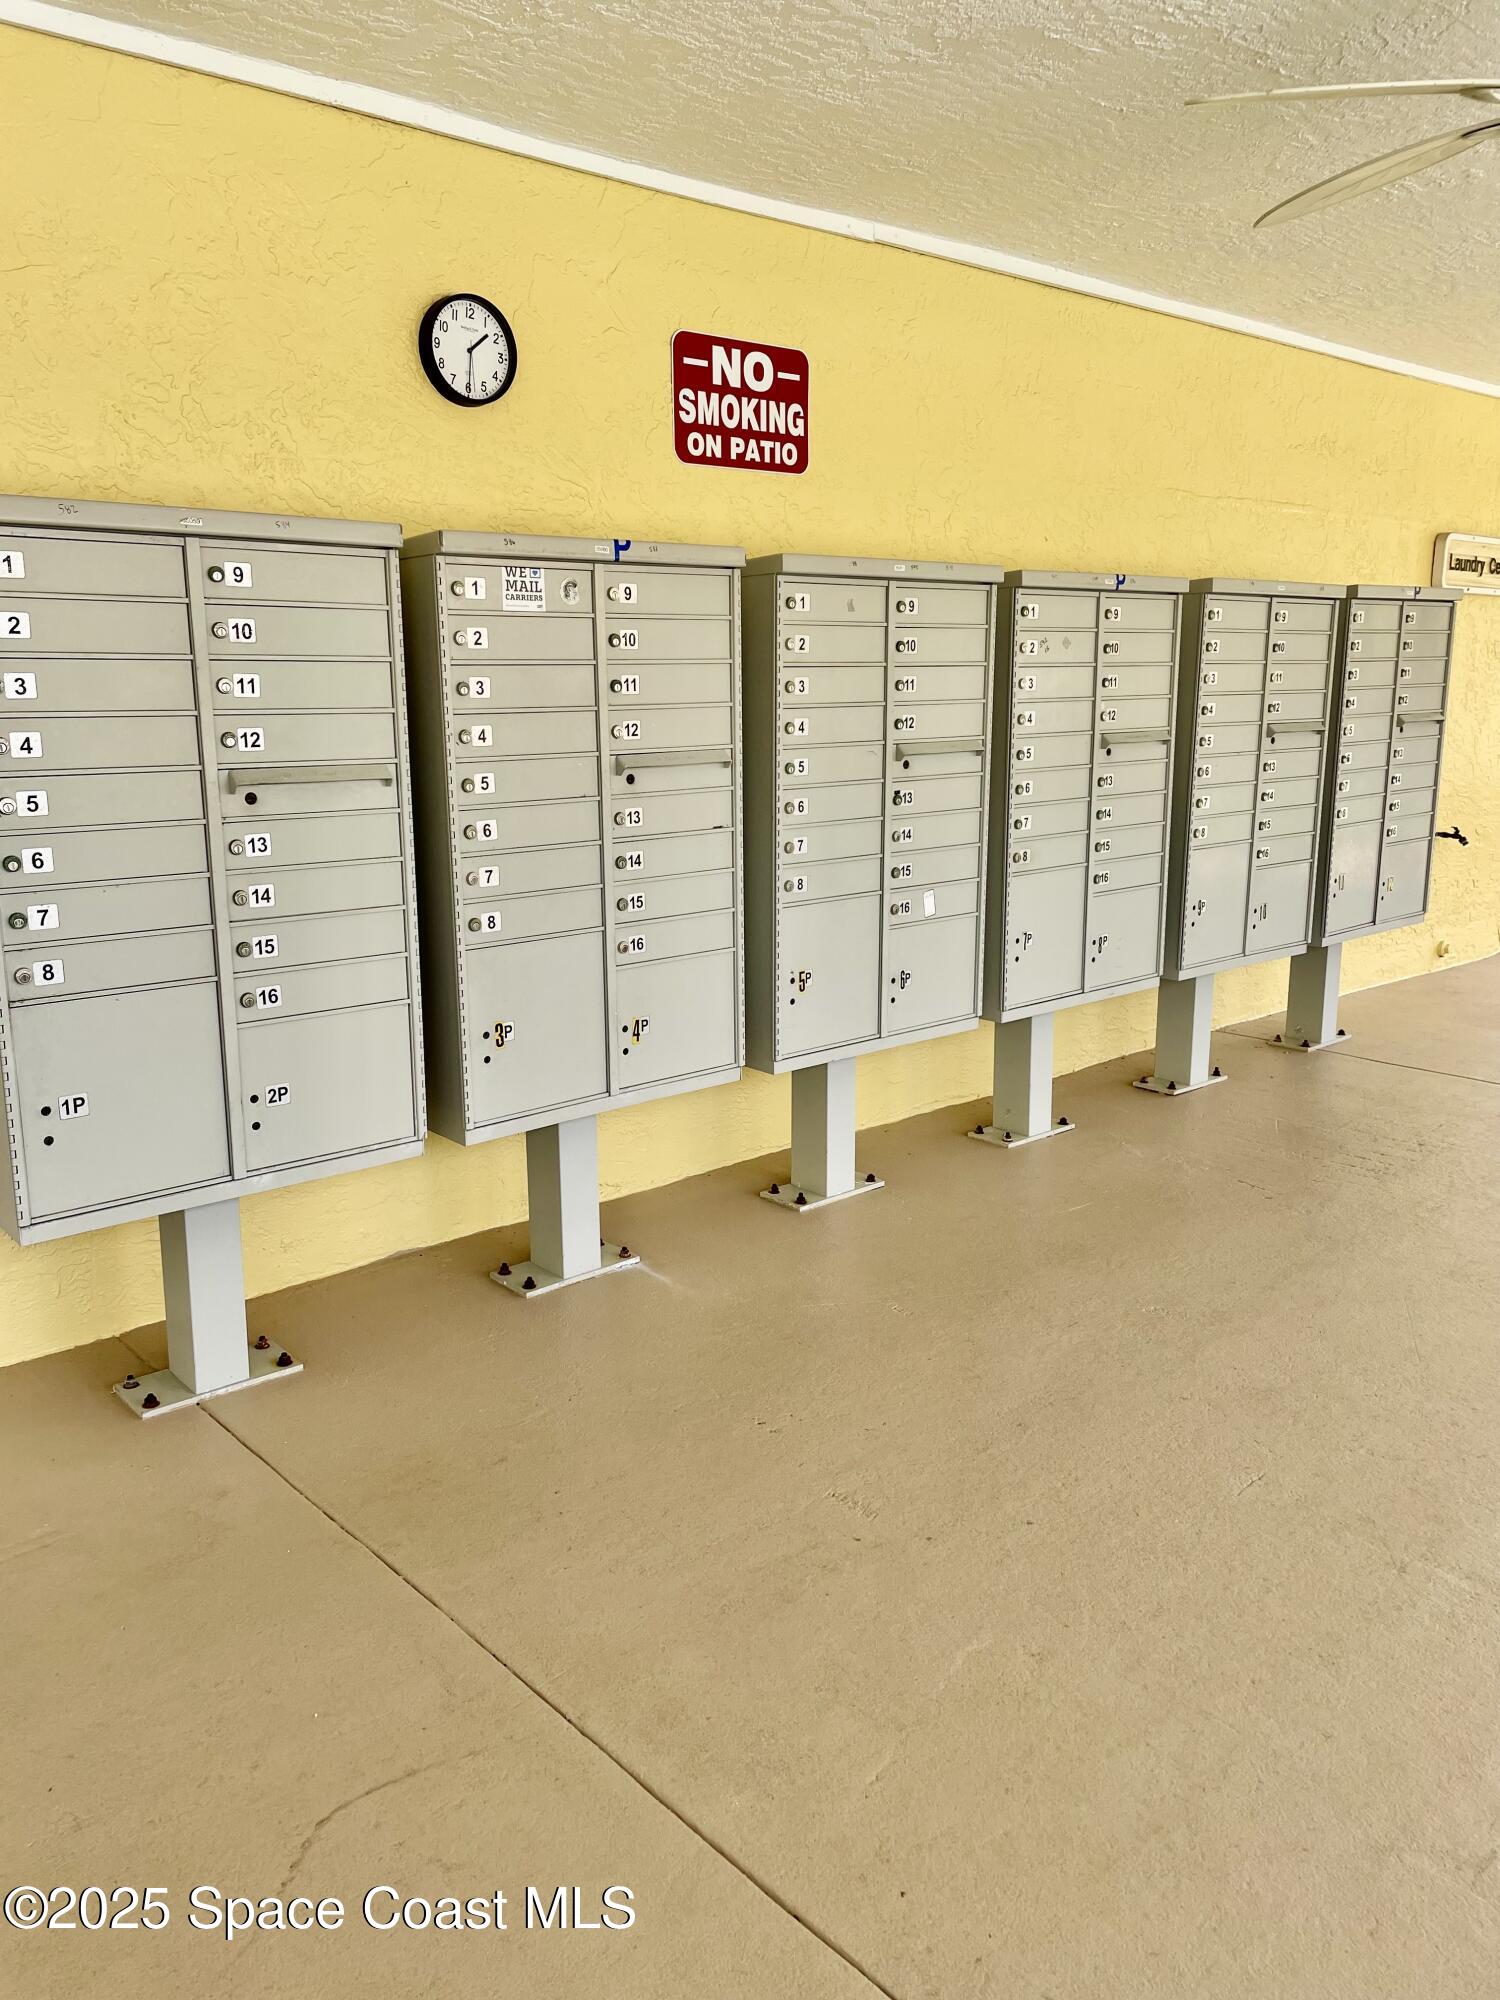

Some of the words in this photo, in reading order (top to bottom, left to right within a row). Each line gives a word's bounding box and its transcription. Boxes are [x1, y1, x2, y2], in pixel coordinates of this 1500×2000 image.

[452, 309, 458, 321] 11
[466, 307, 475, 319] 12
[440, 320, 449, 332] 10
[484, 317, 487, 328] 1
[434, 337, 440, 348] 9
[493, 333, 500, 344] 2
[439, 357, 445, 369] 8
[498, 353, 504, 364] 3
[712, 345, 774, 392] NO
[450, 373, 456, 384] 7
[492, 371, 498, 381] 4
[466, 383, 471, 393] 6
[481, 381, 487, 392] 5
[679, 388, 804, 436] SMOKING
[687, 431, 722, 458] ON
[730, 436, 798, 466] PATIO
[613, 539, 631, 562] P
[2, 555, 13, 574] 1
[1449, 553, 1485, 577] Laundry
[232, 567, 244, 583] 9
[505, 566, 527, 578] WE
[471, 581, 479, 595] 1
[505, 580, 542, 593] MAIL
[505, 593, 543, 602] CARRIERS
[624, 586, 632, 600] 9
[800, 597, 805, 609] 1
[908, 601, 914, 612] 9
[1031, 607, 1035, 617] 1
[1113, 609, 1119, 619] 9
[8, 617, 22, 634] 2
[231, 623, 253, 640] 10
[474, 631, 482, 645] 2
[622, 632, 636, 647] 10
[799, 638, 805, 650] 2
[905, 640, 916, 651] 10
[1030, 643, 1035, 653] 2
[1110, 643, 1118, 653] 10
[14, 677, 27, 696] 3
[236, 678, 256, 694] 11
[476, 681, 484, 695] 3
[623, 678, 637, 692] 11
[799, 680, 805, 692] 3
[905, 679, 914, 690] 11
[1028, 678, 1033, 688] 3
[1109, 677, 1117, 687] 11
[1027, 714, 1032, 723] 4
[1107, 711, 1116, 720] 12
[798, 722, 805, 733] 4
[904, 717, 914, 729] 12
[478, 729, 487, 743] 4
[624, 723, 639, 738] 12
[20, 736, 33, 754] 4
[240, 732, 261, 748] 12
[1026, 748, 1031, 758] 5
[798, 761, 804, 773] 5
[481, 776, 489, 790] 5
[1105, 776, 1112, 786] 13
[1025, 783, 1030, 793] 6
[27, 795, 39, 813] 5
[902, 792, 912, 804] 13
[798, 800, 804, 812] 6
[627, 811, 641, 825] 13
[1103, 809, 1111, 818] 14
[1024, 818, 1029, 828] 7
[483, 823, 491, 838] 6
[901, 829, 911, 840] 14
[248, 836, 268, 853] 13
[797, 840, 804, 852] 7
[1101, 842, 1110, 851] 15
[32, 853, 44, 870] 6
[628, 854, 642, 867] 14
[1022, 852, 1027, 861] 8
[485, 870, 493, 883] 7
[900, 866, 911, 876] 15
[1100, 873, 1108, 882] 16
[797, 879, 803, 890] 8
[251, 888, 272, 904] 14
[630, 896, 643, 909] 15
[900, 902, 910, 913] 16
[36, 910, 50, 927] 7
[487, 916, 496, 929] 8
[255, 939, 275, 955] 15
[630, 937, 644, 951] 16
[1023, 933, 1032, 950] 7P
[1098, 936, 1107, 953] 8P
[43, 964, 55, 981] 8
[799, 971, 812, 992] 5P
[900, 970, 911, 990] 6P
[259, 989, 279, 1005] 16
[495, 1022, 513, 1048] 3P
[632, 1019, 649, 1042] 4P
[268, 1086, 289, 1103] 2P
[61, 1096, 86, 1116] 1P
